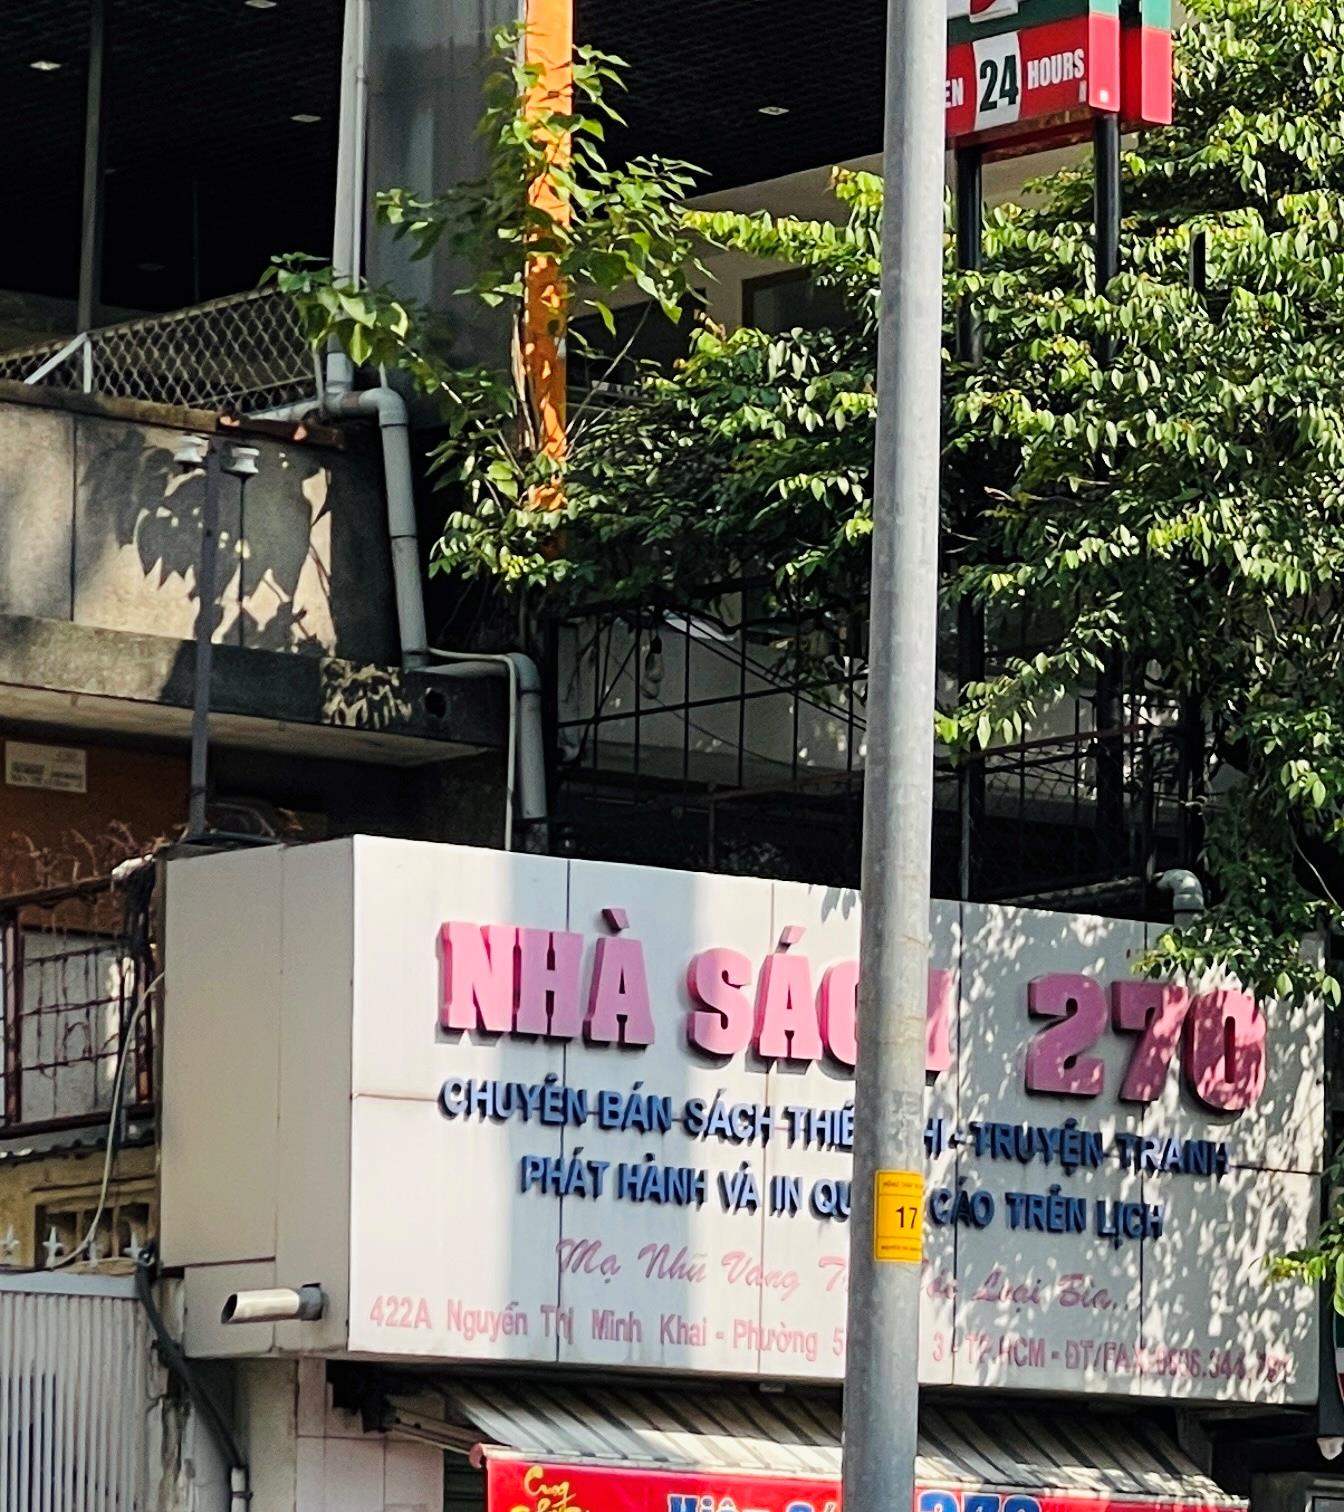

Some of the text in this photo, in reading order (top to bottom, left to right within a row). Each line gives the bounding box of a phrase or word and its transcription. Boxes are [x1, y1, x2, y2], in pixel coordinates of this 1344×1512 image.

[979, 54, 1019, 112] 24
[1027, 48, 1085, 90] HOURS
[439, 908, 656, 1047] NHÀ
[1027, 971, 1268, 1112] 270
[440, 1072, 587, 1127] CHUYÊN
[600, 1081, 672, 1134] BÁN
[685, 1089, 774, 1145] SÁCH
[1116, 1132, 1229, 1183] TRANH
[521, 1147, 610, 1199] PHÁT
[618, 1153, 707, 1206] HÀNH
[719, 1161, 760, 1213] VÀ
[770, 1173, 803, 1217] IN
[929, 1175, 995, 1229] CÁO
[1005, 1183, 1086, 1234] TRÊN
[1096, 1199, 1165, 1250] LỊCH
[896, 1205, 918, 1229] 17
[370, 1296, 433, 1330] 422A
[591, 1309, 643, 1344] Minh
[660, 1313, 708, 1348] Khai
